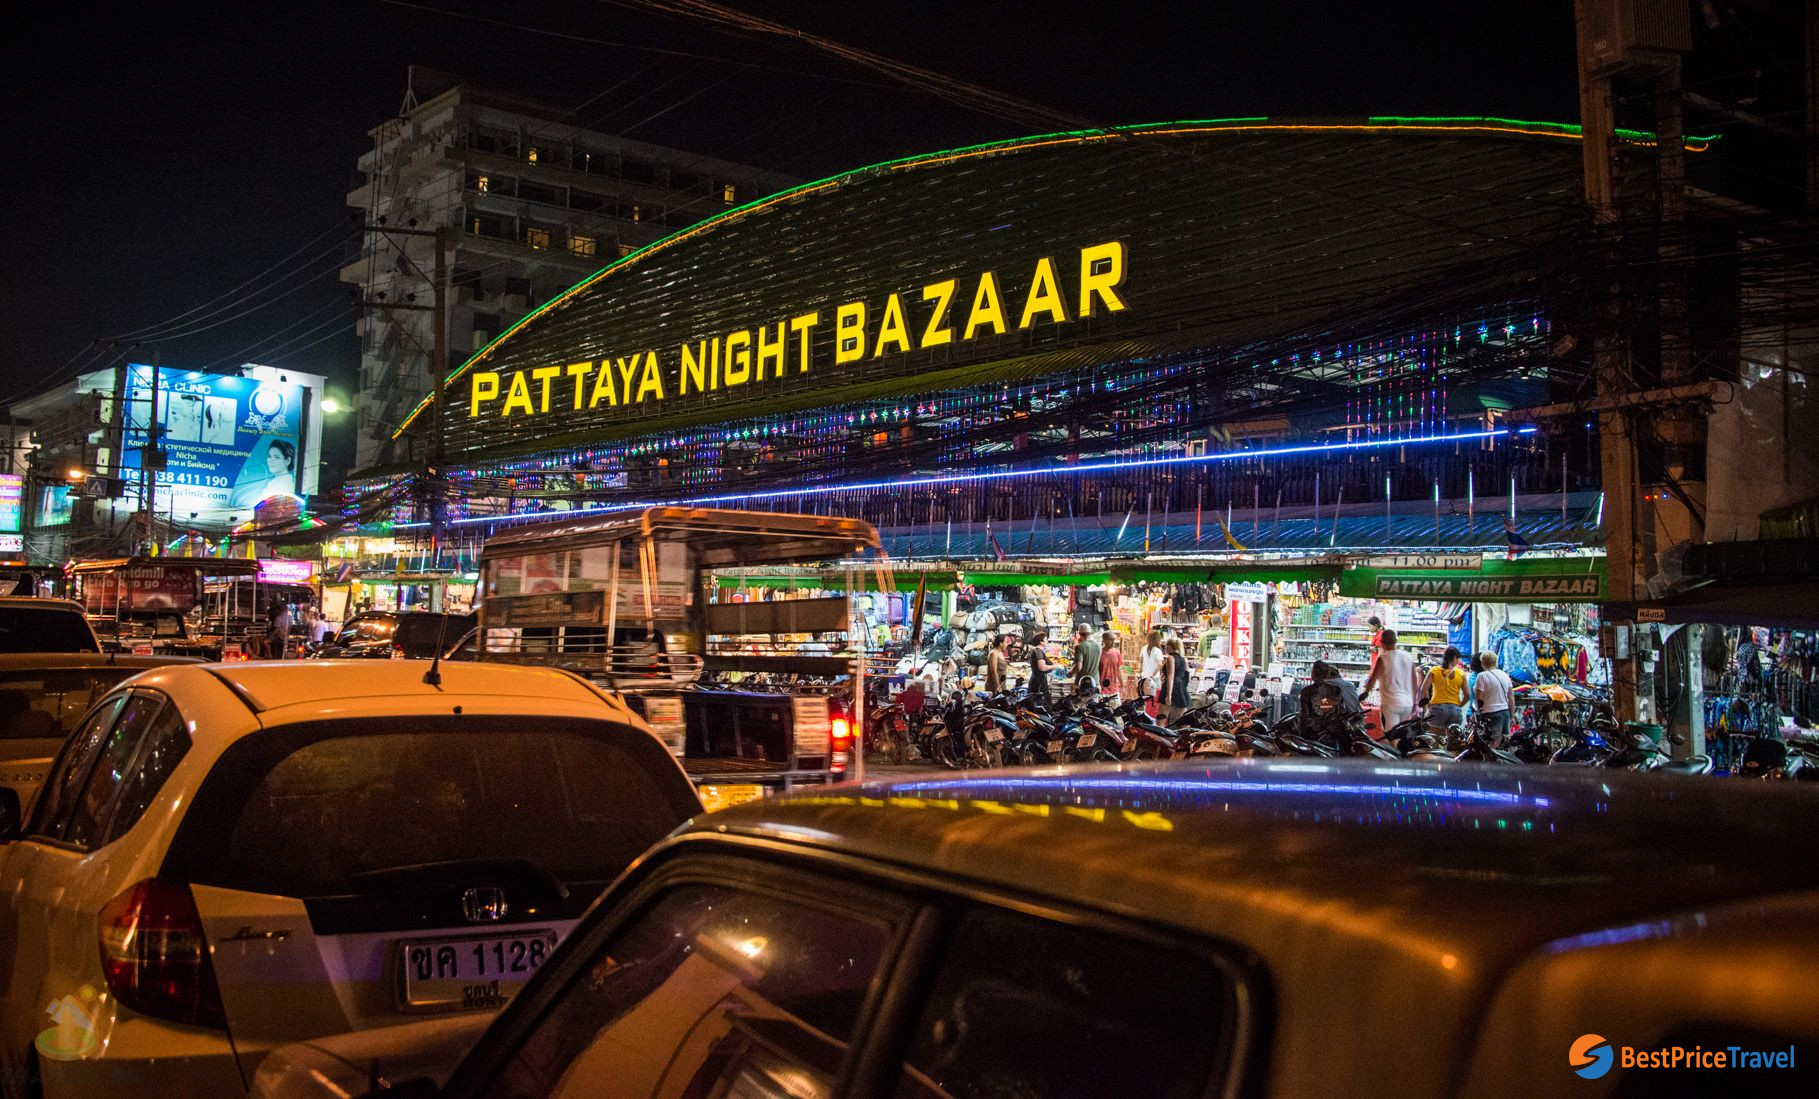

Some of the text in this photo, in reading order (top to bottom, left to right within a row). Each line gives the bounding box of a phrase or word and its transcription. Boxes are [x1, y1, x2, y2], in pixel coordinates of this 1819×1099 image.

[470, 241, 1126, 418] PATTAYA NIGHT BAZAAR
[175, 382, 212, 394] CLINIC
[176, 452, 197, 460] Nicha
[177, 472, 200, 485] 411
[205, 475, 228, 488] 190
[1444, 557, 1470, 569] pm
[1379, 579, 1597, 595] PATTAYA NIGHT BAZAAR
[473, 938, 546, 975] 1128
